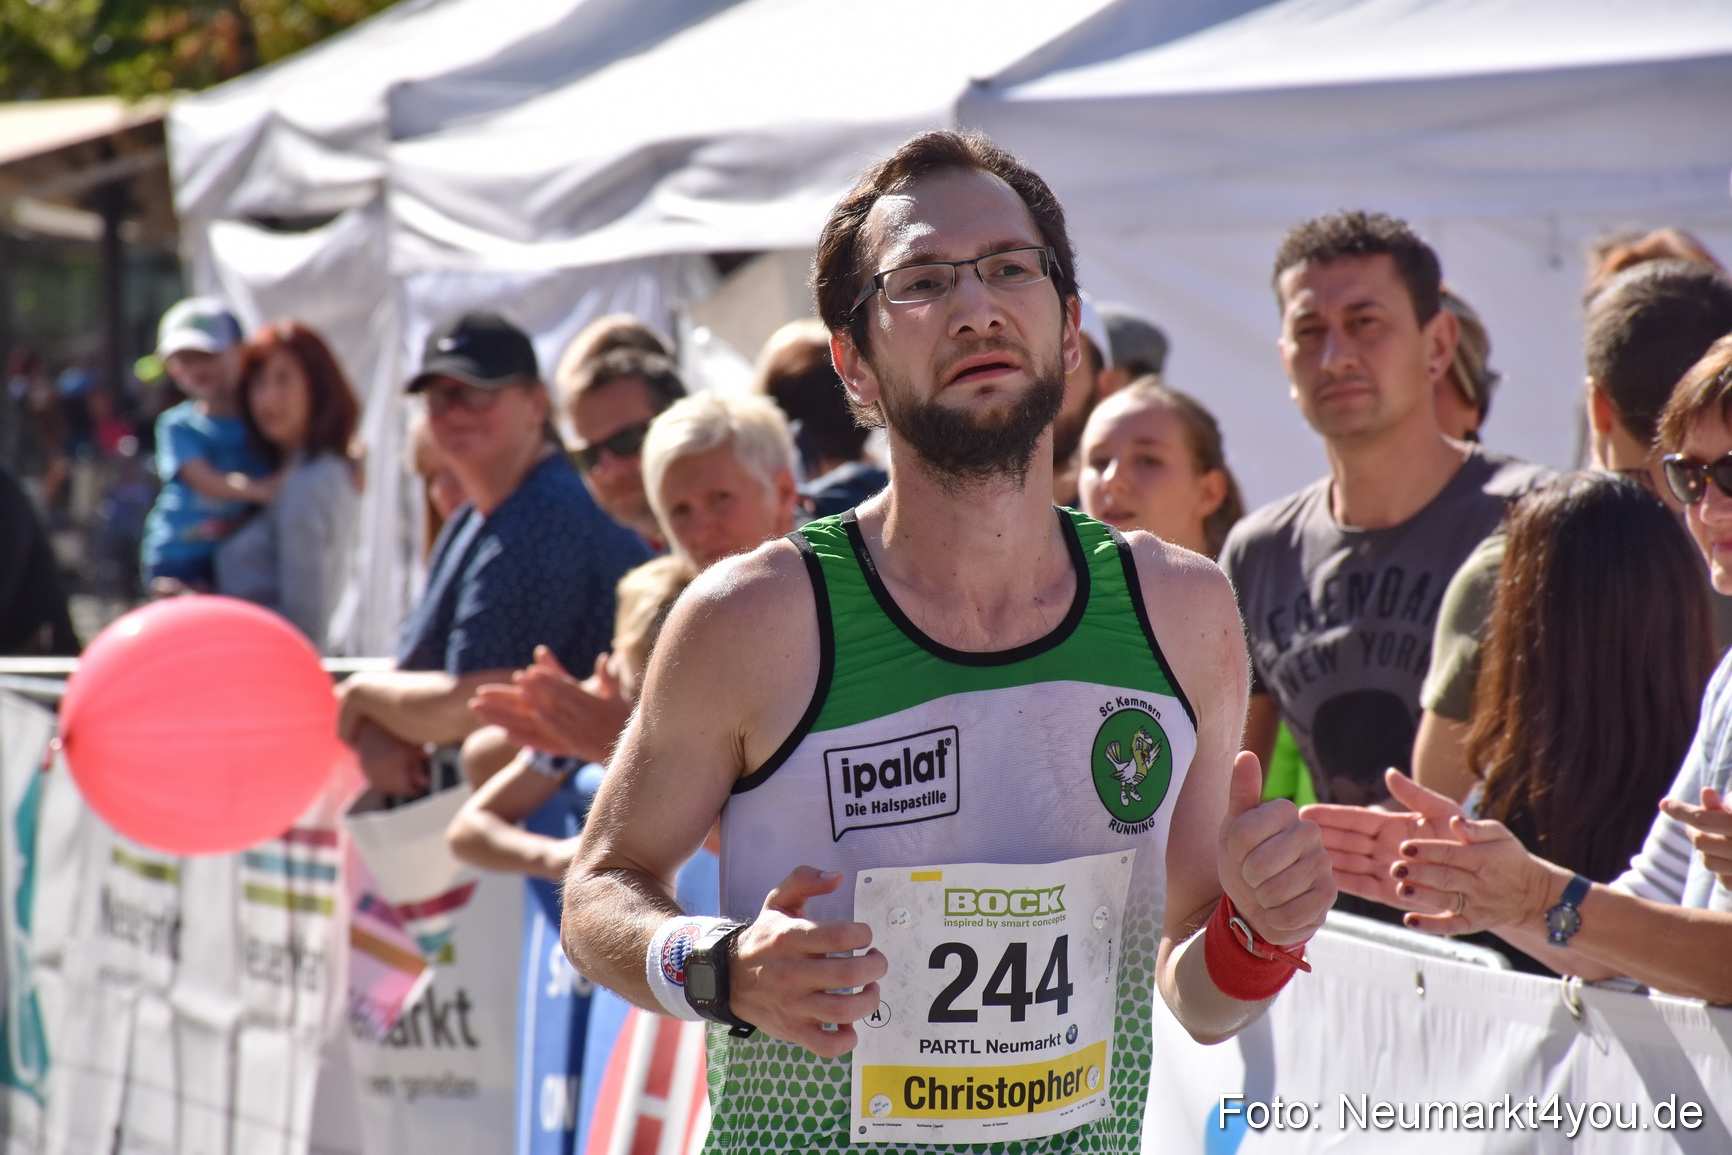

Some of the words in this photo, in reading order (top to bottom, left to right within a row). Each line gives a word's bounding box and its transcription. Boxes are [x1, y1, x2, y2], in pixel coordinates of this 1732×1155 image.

[1099, 700, 1114, 718] SC
[1115, 696, 1162, 721] Kemmern
[845, 802, 867, 817] Die
[871, 790, 947, 814] Halspastille
[1108, 816, 1156, 836] RUNNING
[944, 884, 1067, 918] BOCK
[944, 918, 984, 929] inspired
[986, 918, 999, 929] by
[1001, 919, 1030, 928] smart
[1032, 914, 1067, 927] concepts
[927, 934, 1074, 1024] 244
[870, 1009, 882, 1022] A
[919, 1039, 981, 1055] PARTL
[985, 1033, 1062, 1055] Neumarkt
[903, 1066, 1084, 1113] Christopher
